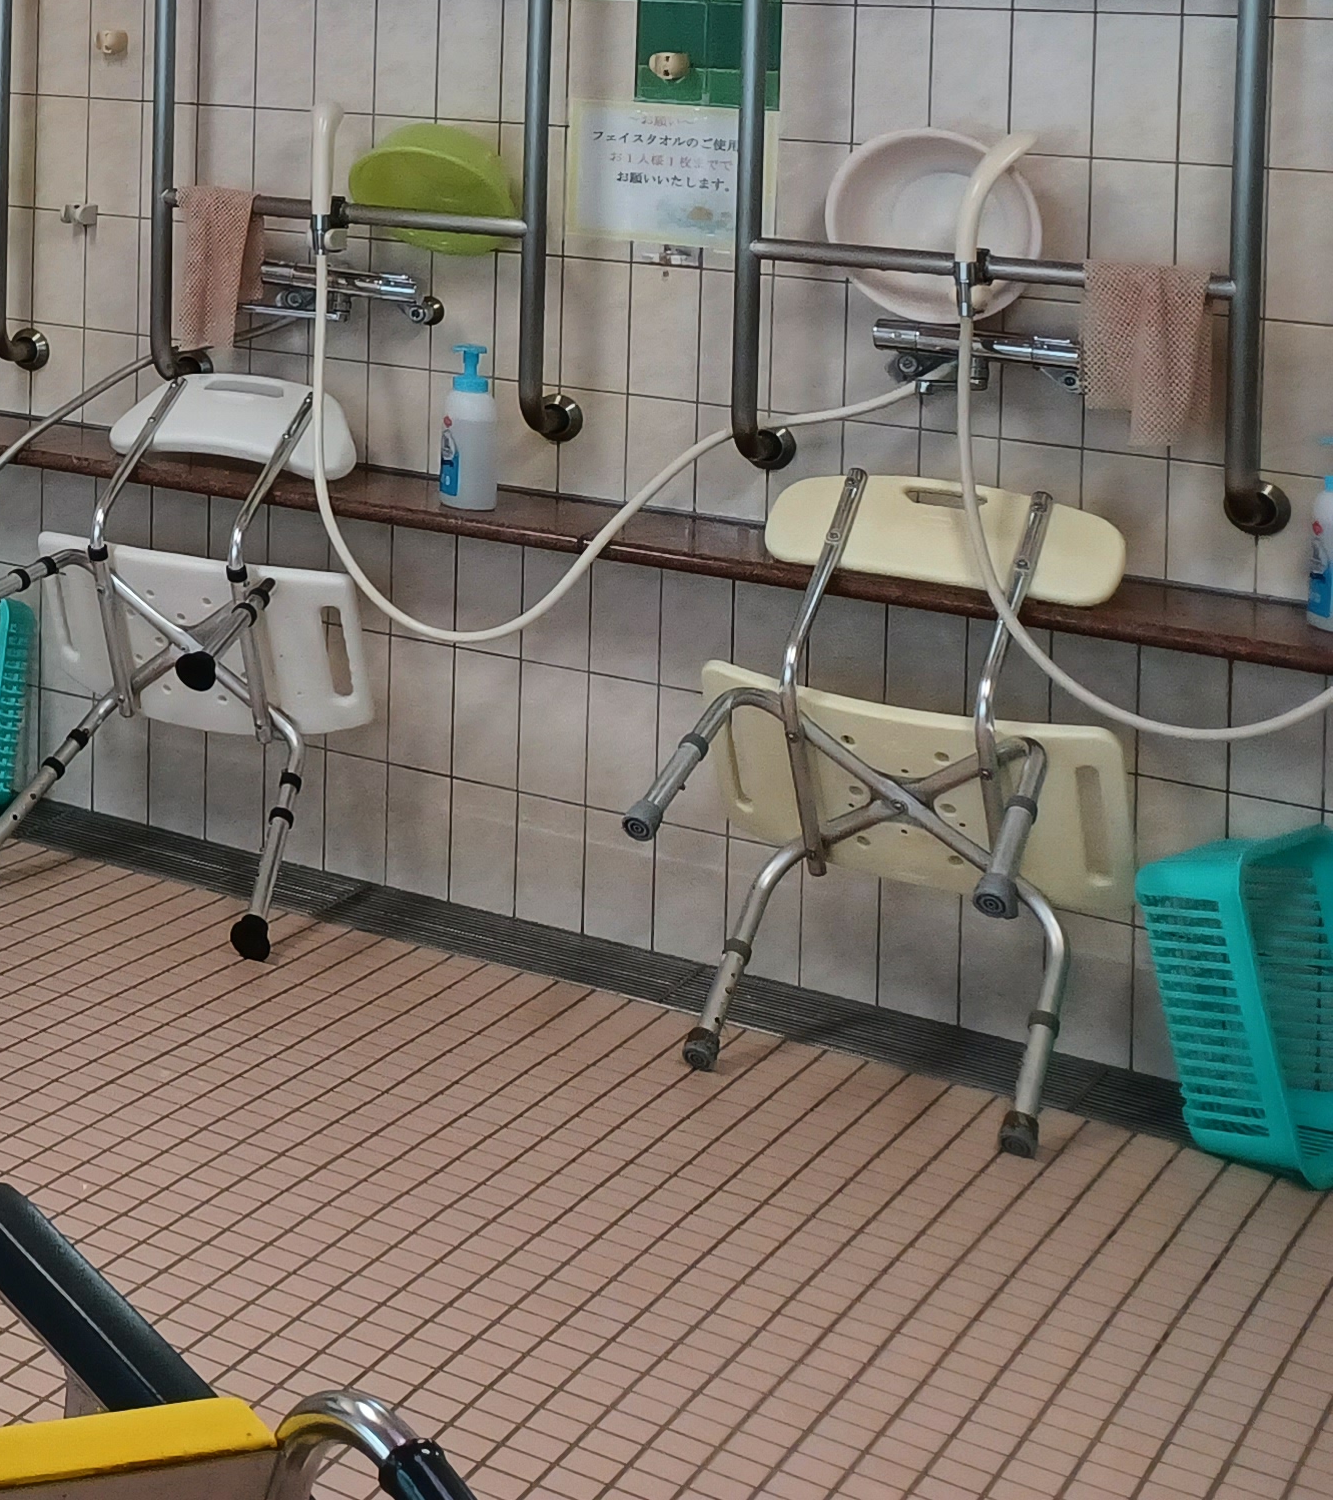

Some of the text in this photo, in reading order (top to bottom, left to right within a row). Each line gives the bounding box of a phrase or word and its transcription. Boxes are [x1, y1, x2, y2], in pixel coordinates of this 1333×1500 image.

[616, 171, 731, 193] お願いいたします。
